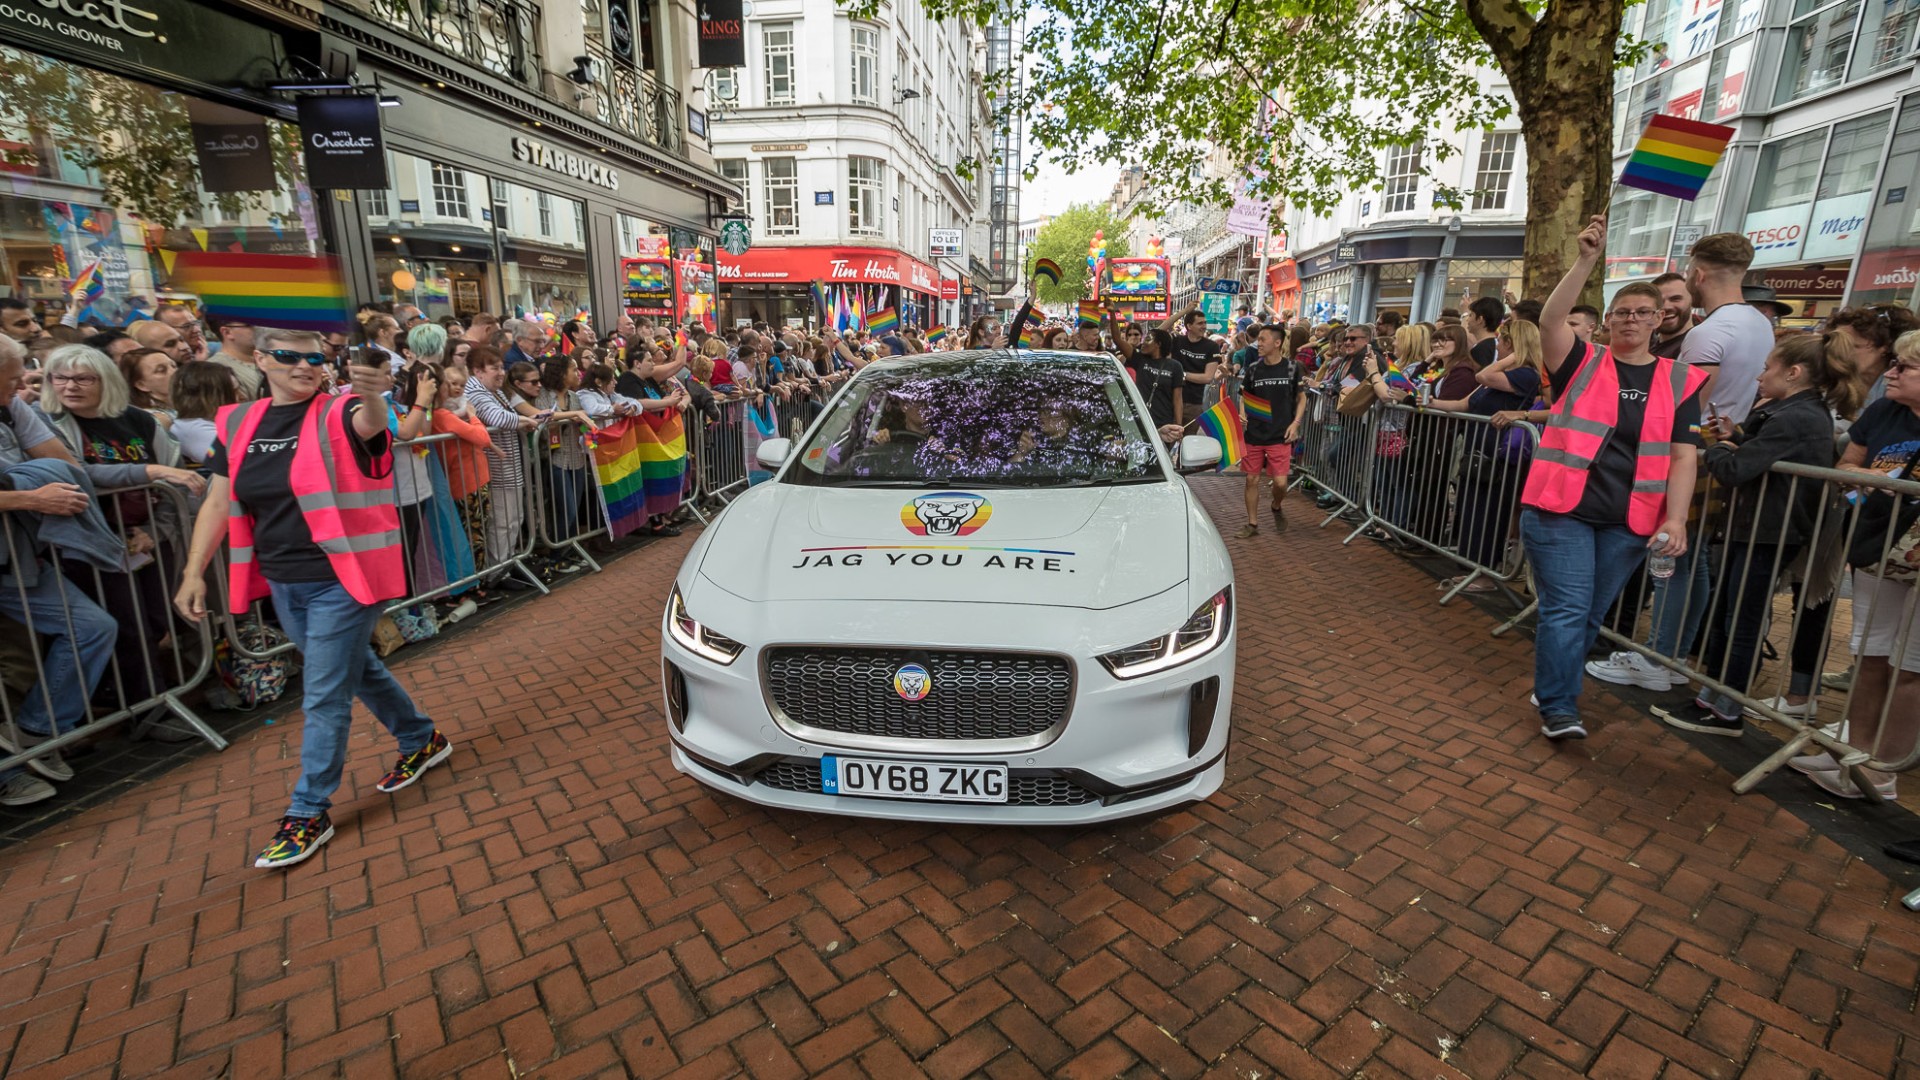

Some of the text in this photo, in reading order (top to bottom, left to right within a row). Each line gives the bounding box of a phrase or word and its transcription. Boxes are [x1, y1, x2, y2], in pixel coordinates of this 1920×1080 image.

[702, 20, 740, 34] KINGS
[56, 22, 124, 52] GROWER
[516, 137, 619, 191] STARBUCKS
[1747, 225, 1801, 244] TESCO
[830, 259, 857, 278] Tim
[259, 442, 287, 453] YOU
[792, 553, 1075, 573] JAG YOU ARE.
[845, 762, 1003, 796] OY68 ZKG
